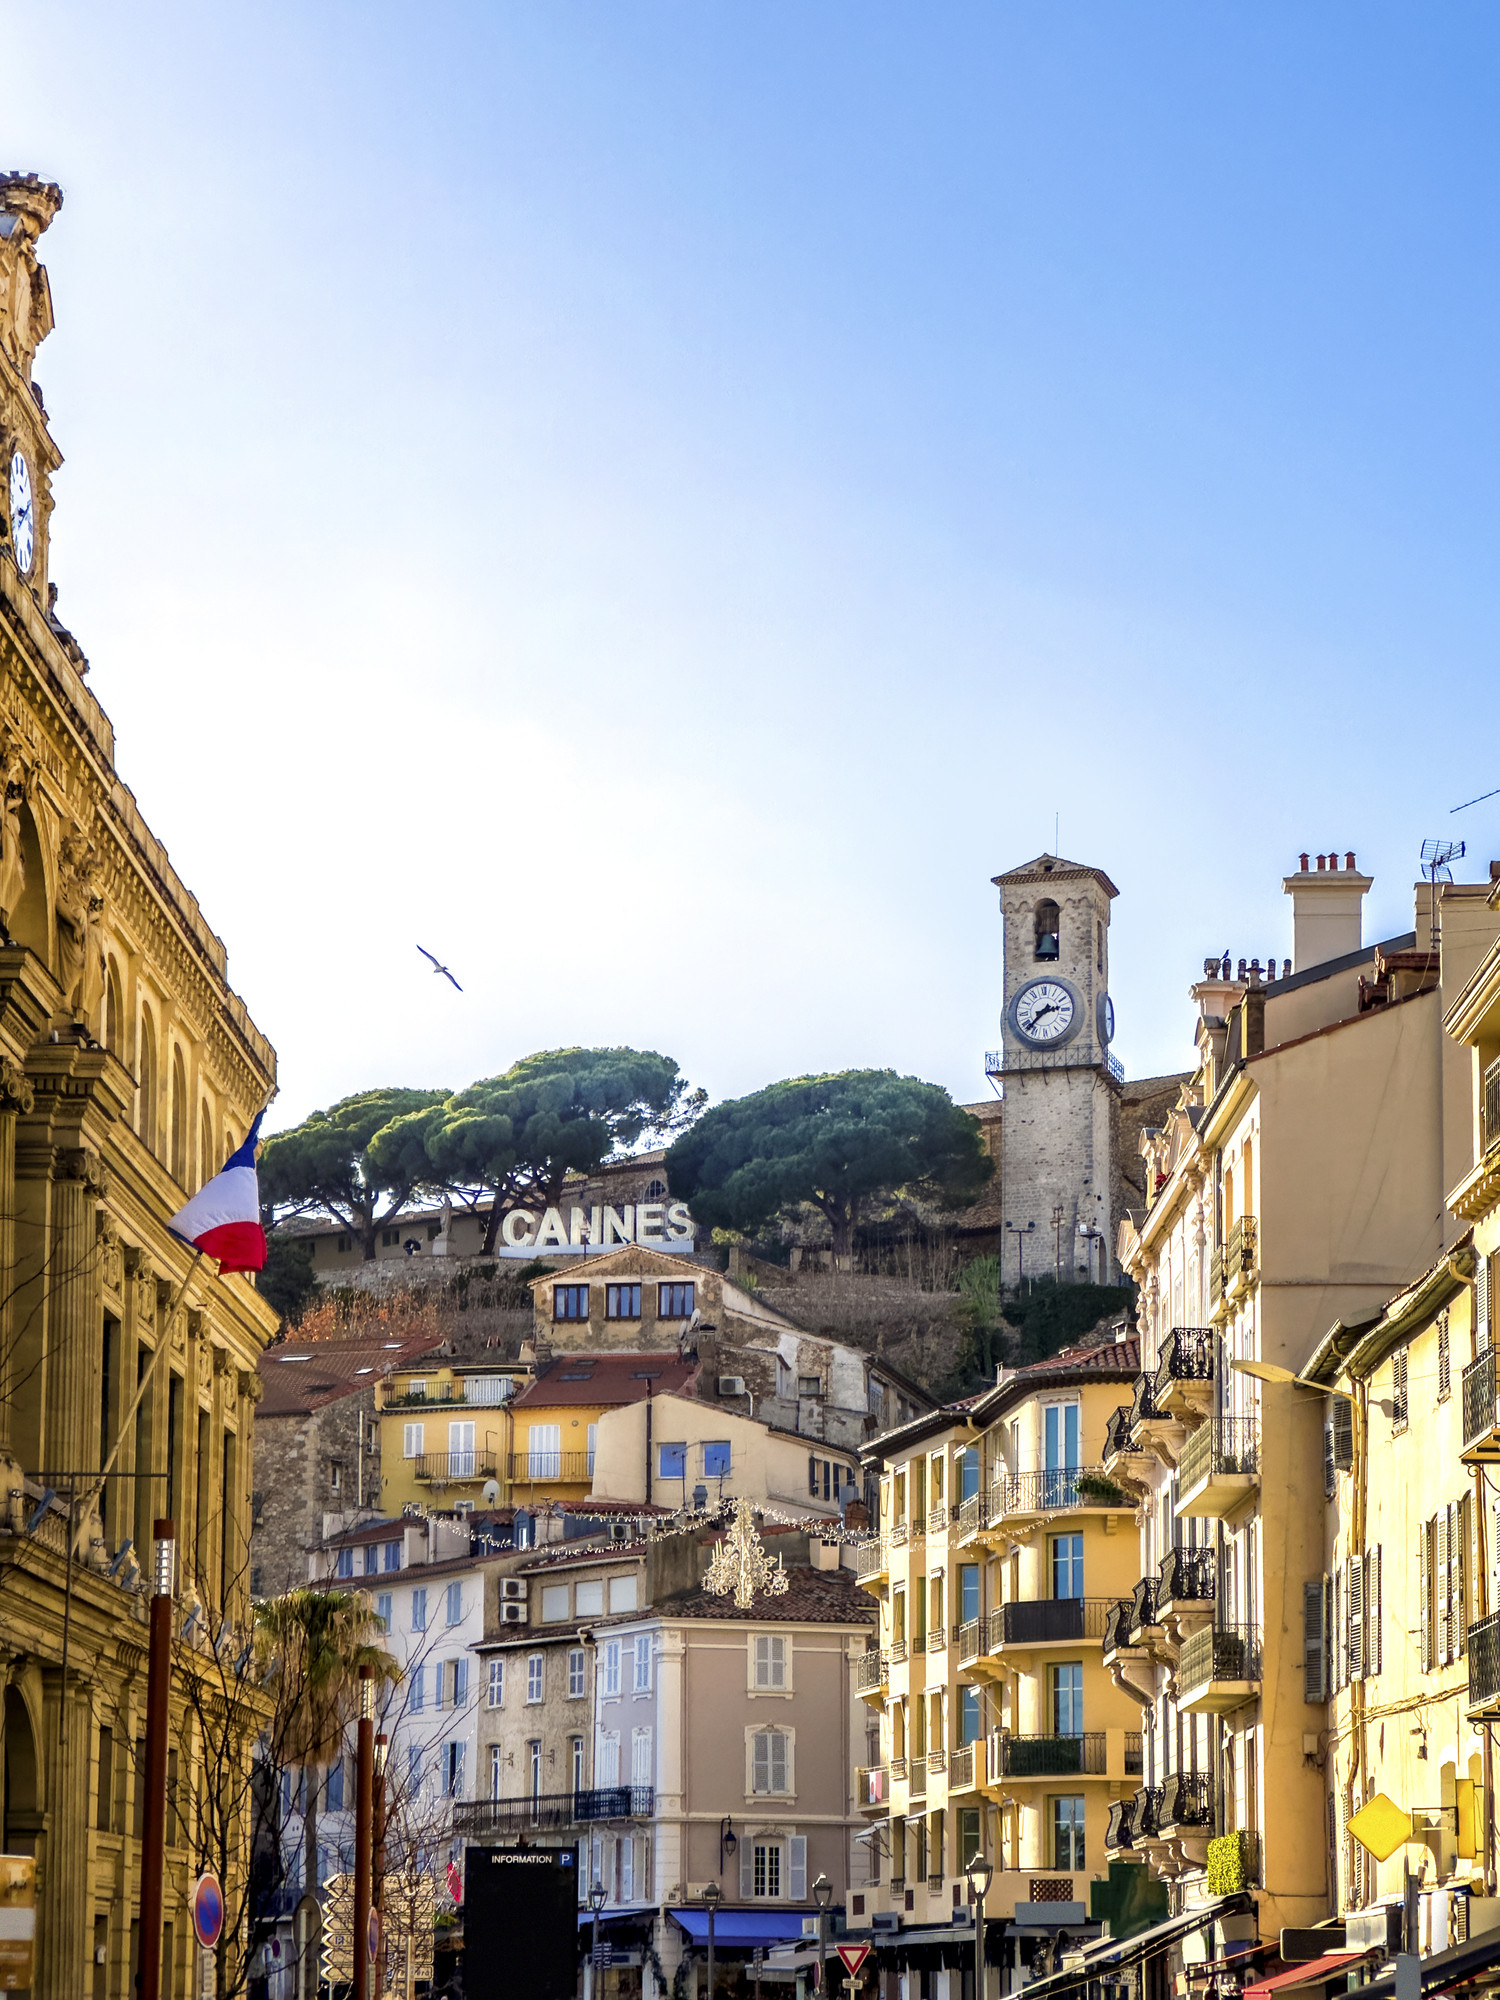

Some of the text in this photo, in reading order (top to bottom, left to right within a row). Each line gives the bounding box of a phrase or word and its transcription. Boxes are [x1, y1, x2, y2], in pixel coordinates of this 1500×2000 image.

[502, 1203, 693, 1247] CANNES
[491, 1854, 570, 1865] INFORMATION P
